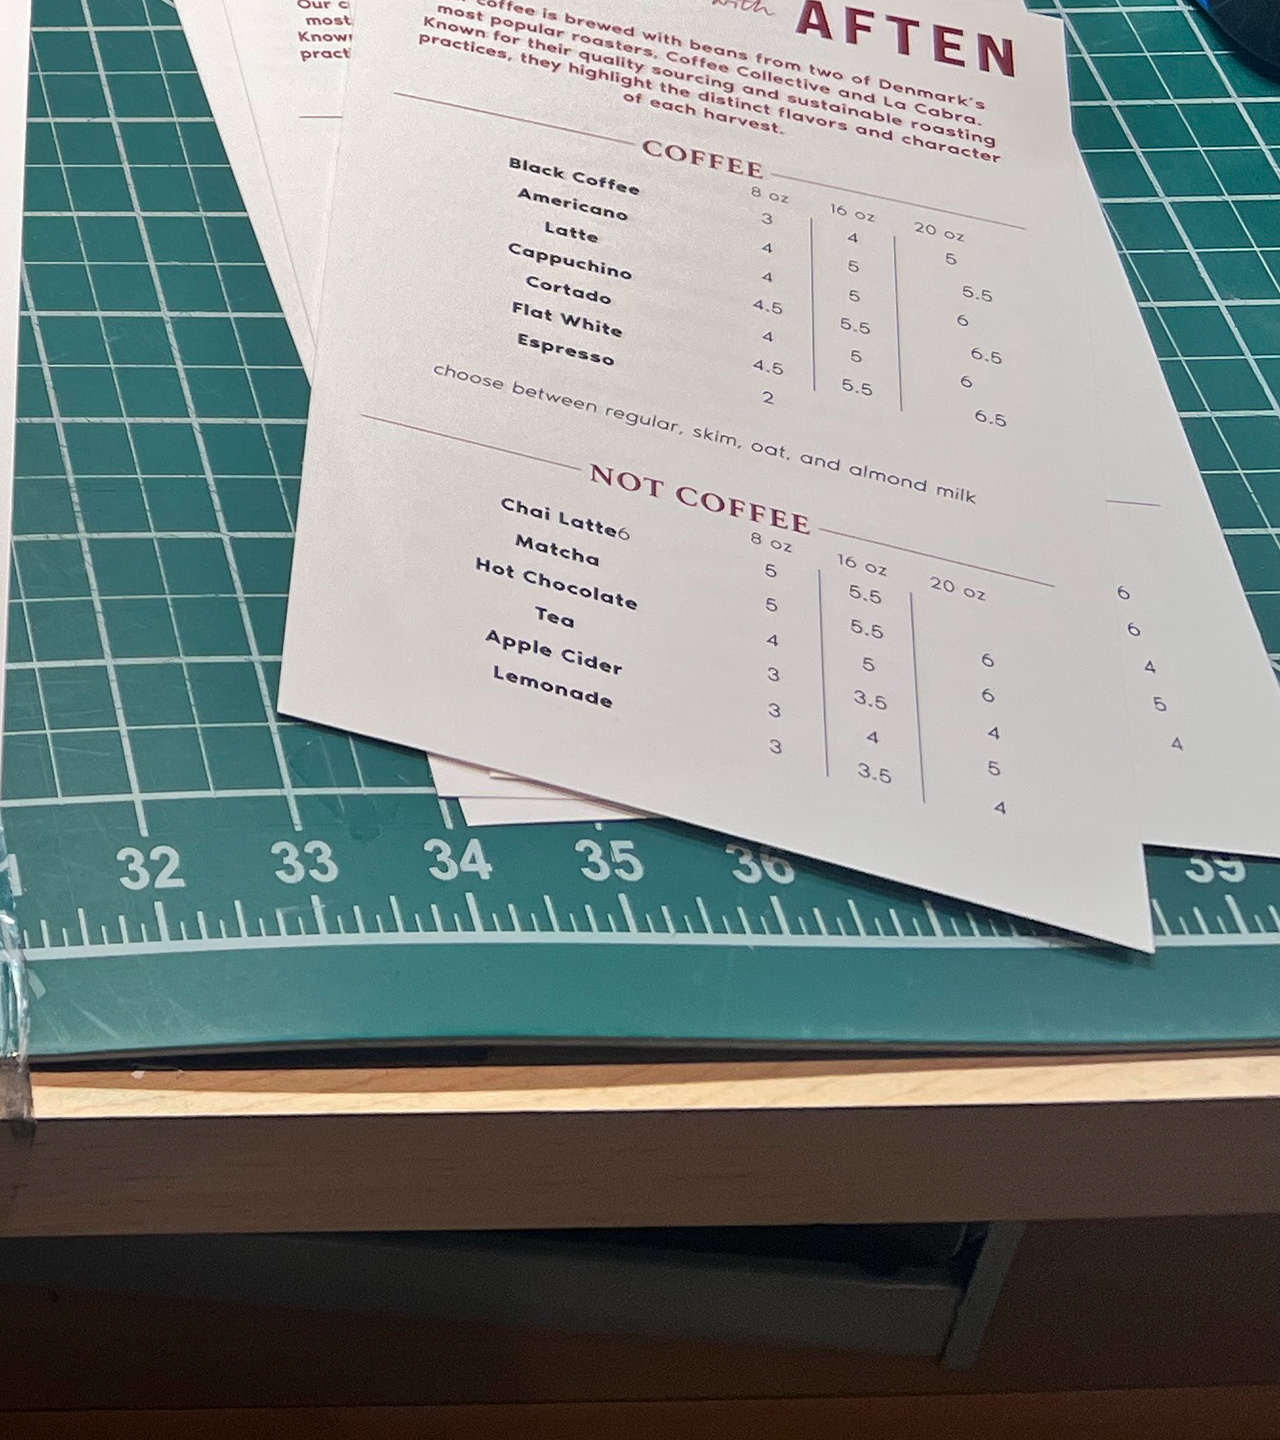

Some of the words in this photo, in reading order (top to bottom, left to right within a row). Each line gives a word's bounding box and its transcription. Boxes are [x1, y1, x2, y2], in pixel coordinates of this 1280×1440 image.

[796, 0, 1015, 77] AFTEN
[437, 5, 483, 21] most
[490, 16, 565, 37] popular
[572, 33, 657, 59] roasters,
[666, 52, 729, 73] Coffee
[737, 66, 830, 94] Collective
[838, 90, 875, 103] and
[884, 96, 906, 110] La
[914, 103, 982, 126] Cabra.
[509, 157, 564, 179] Black
[572, 172, 640, 195] Coffee
[642, 140, 763, 179] COFFEE
[517, 188, 628, 220] Americano
[831, 203, 847, 216] 16
[855, 211, 875, 222] oz
[545, 222, 598, 243] Latte
[753, 300, 783, 314] 4.5
[841, 318, 870, 334] 5.5
[518, 333, 614, 366] Espresso
[591, 464, 664, 497] NOT
[676, 487, 810, 535] COFFEE
[515, 534, 599, 567] Matcha
[476, 557, 514, 578] Hot
[523, 571, 637, 610] Chocolate
[116, 846, 186, 890] 32
[271, 840, 338, 883] 33
[424, 838, 493, 880] 34
[575, 839, 643, 881] 35
[725, 843, 796, 885] 36
